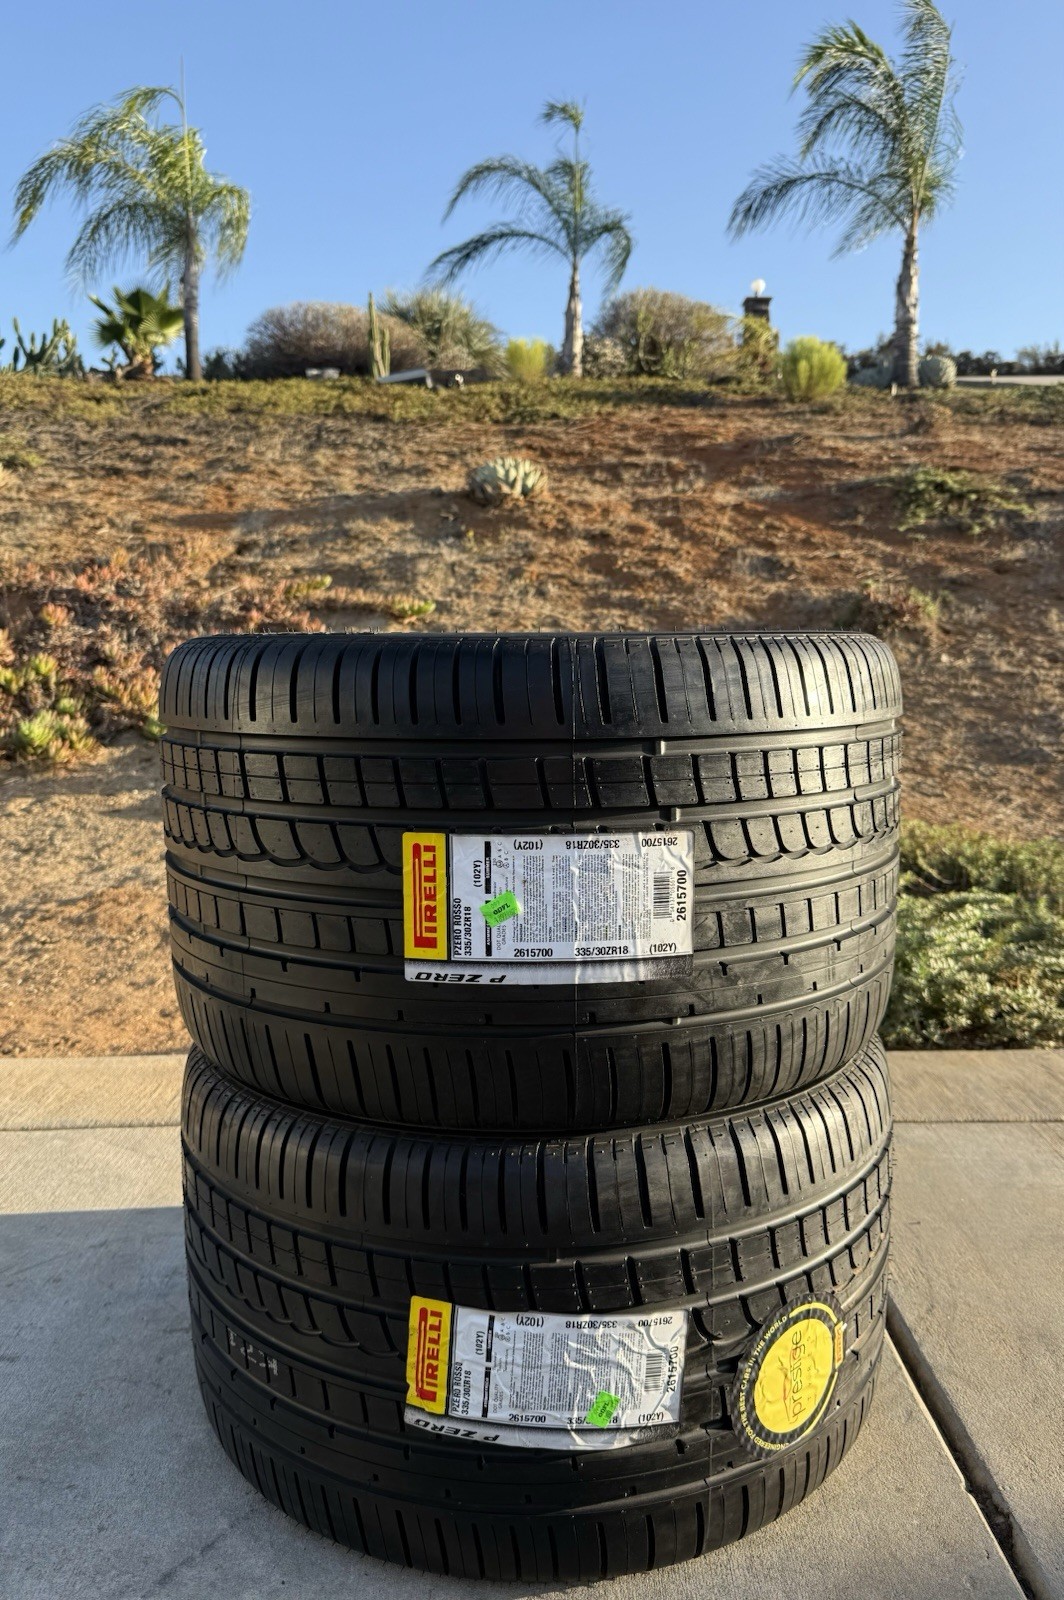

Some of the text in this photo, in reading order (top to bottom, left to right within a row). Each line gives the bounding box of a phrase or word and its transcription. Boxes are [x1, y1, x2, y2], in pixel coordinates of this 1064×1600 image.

[514, 838, 543, 850] (102Y)
[566, 840, 620, 850] 335/30ZR18
[642, 836, 678, 848] 2615700
[474, 860, 482, 887] (102Y)
[412, 842, 437, 948] PIRELLI
[676, 870, 687, 922] 2615700
[453, 898, 462, 956] PZERO ROSSO
[464, 906, 472, 956] 335/30ZR18
[514, 948, 553, 958] 2615700
[574, 946, 628, 956] 335/30ZR18
[650, 943, 676, 954] (102Y)
[415, 972, 507, 984] P ZERO
[516, 1314, 544, 1328] (102Y)
[566, 1320, 618, 1328] 335/30ZR18
[638, 1316, 673, 1328] 2615700
[764, 1316, 788, 1340] WORLD
[476, 1330, 486, 1356] (102Y)
[754, 1342, 765, 1357] THE
[415, 1307, 442, 1402] PIRELLI
[748, 1358, 756, 1366] IN
[666, 1346, 678, 1393] 2615700
[790, 1330, 806, 1418] prestige
[741, 1368, 751, 1390] CARS
[452, 1362, 463, 1414] PZERO ROSSO
[509, 1414, 546, 1423] 2615700
[638, 1412, 664, 1423] (102Y)
[414, 1418, 500, 1442] P ZERO
[746, 1426, 756, 1440] FOR
